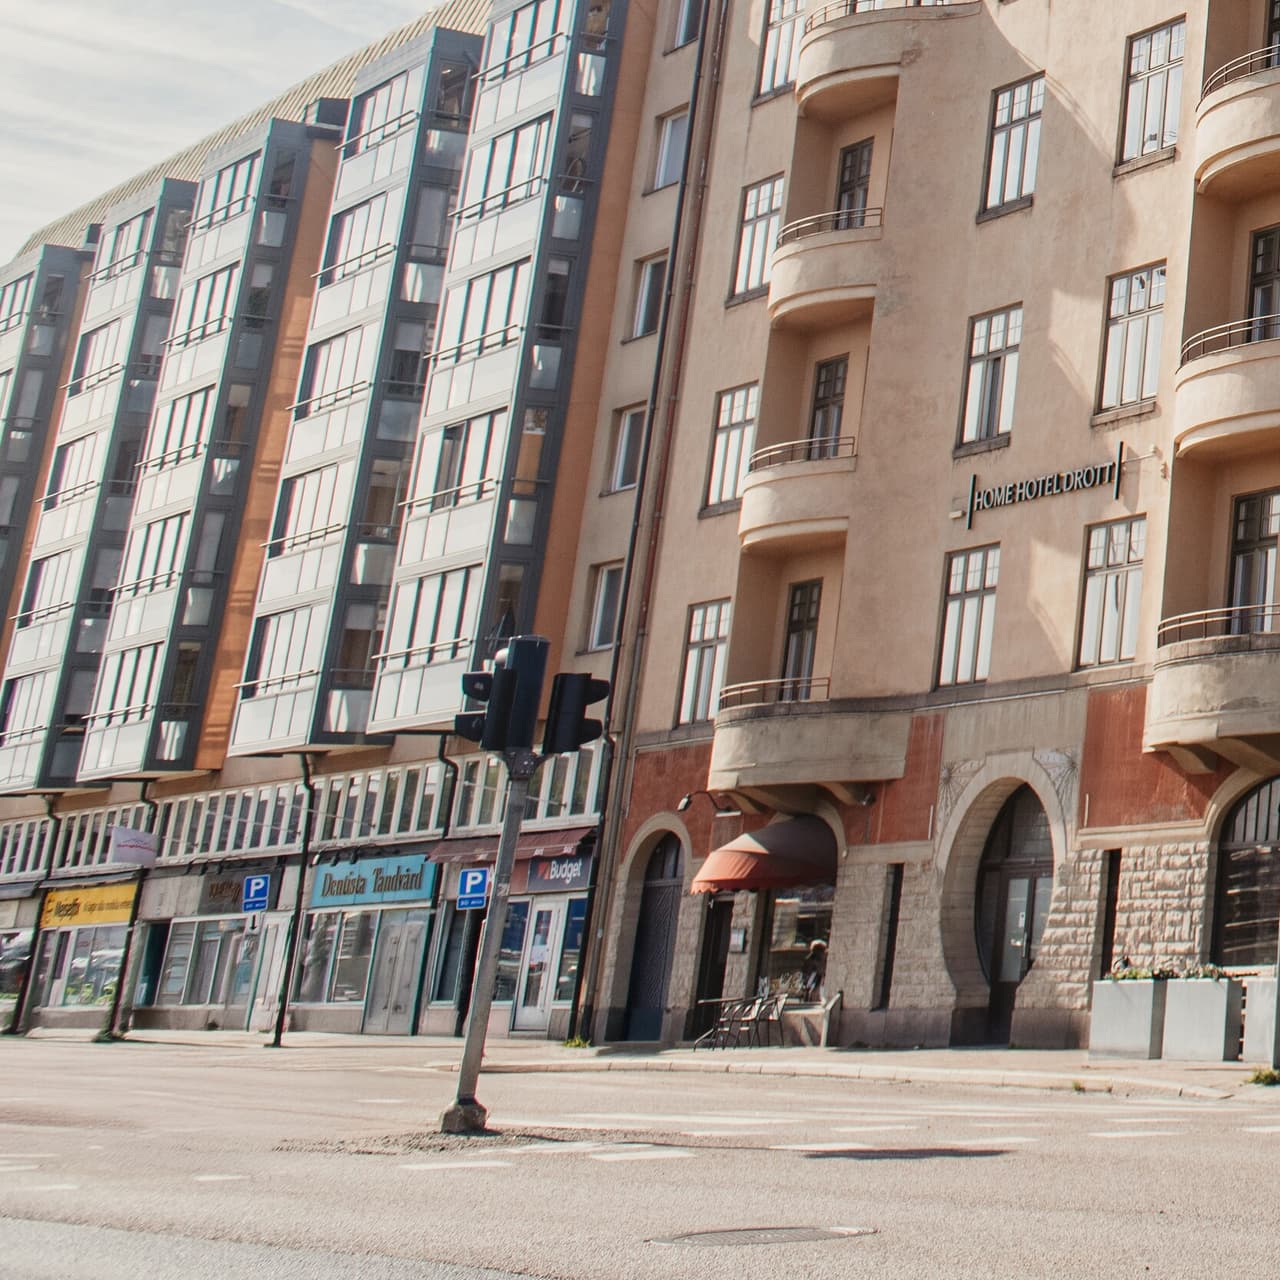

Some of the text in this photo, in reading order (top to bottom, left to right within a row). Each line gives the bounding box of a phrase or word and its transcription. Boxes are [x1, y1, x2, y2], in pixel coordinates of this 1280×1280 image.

[974, 462, 1115, 512] HOME HOTEL DROTT
[321, 864, 424, 897] Dentista Tandvård
[466, 872, 483, 894] P
[550, 859, 583, 884] Budget
[249, 878, 265, 898] P
